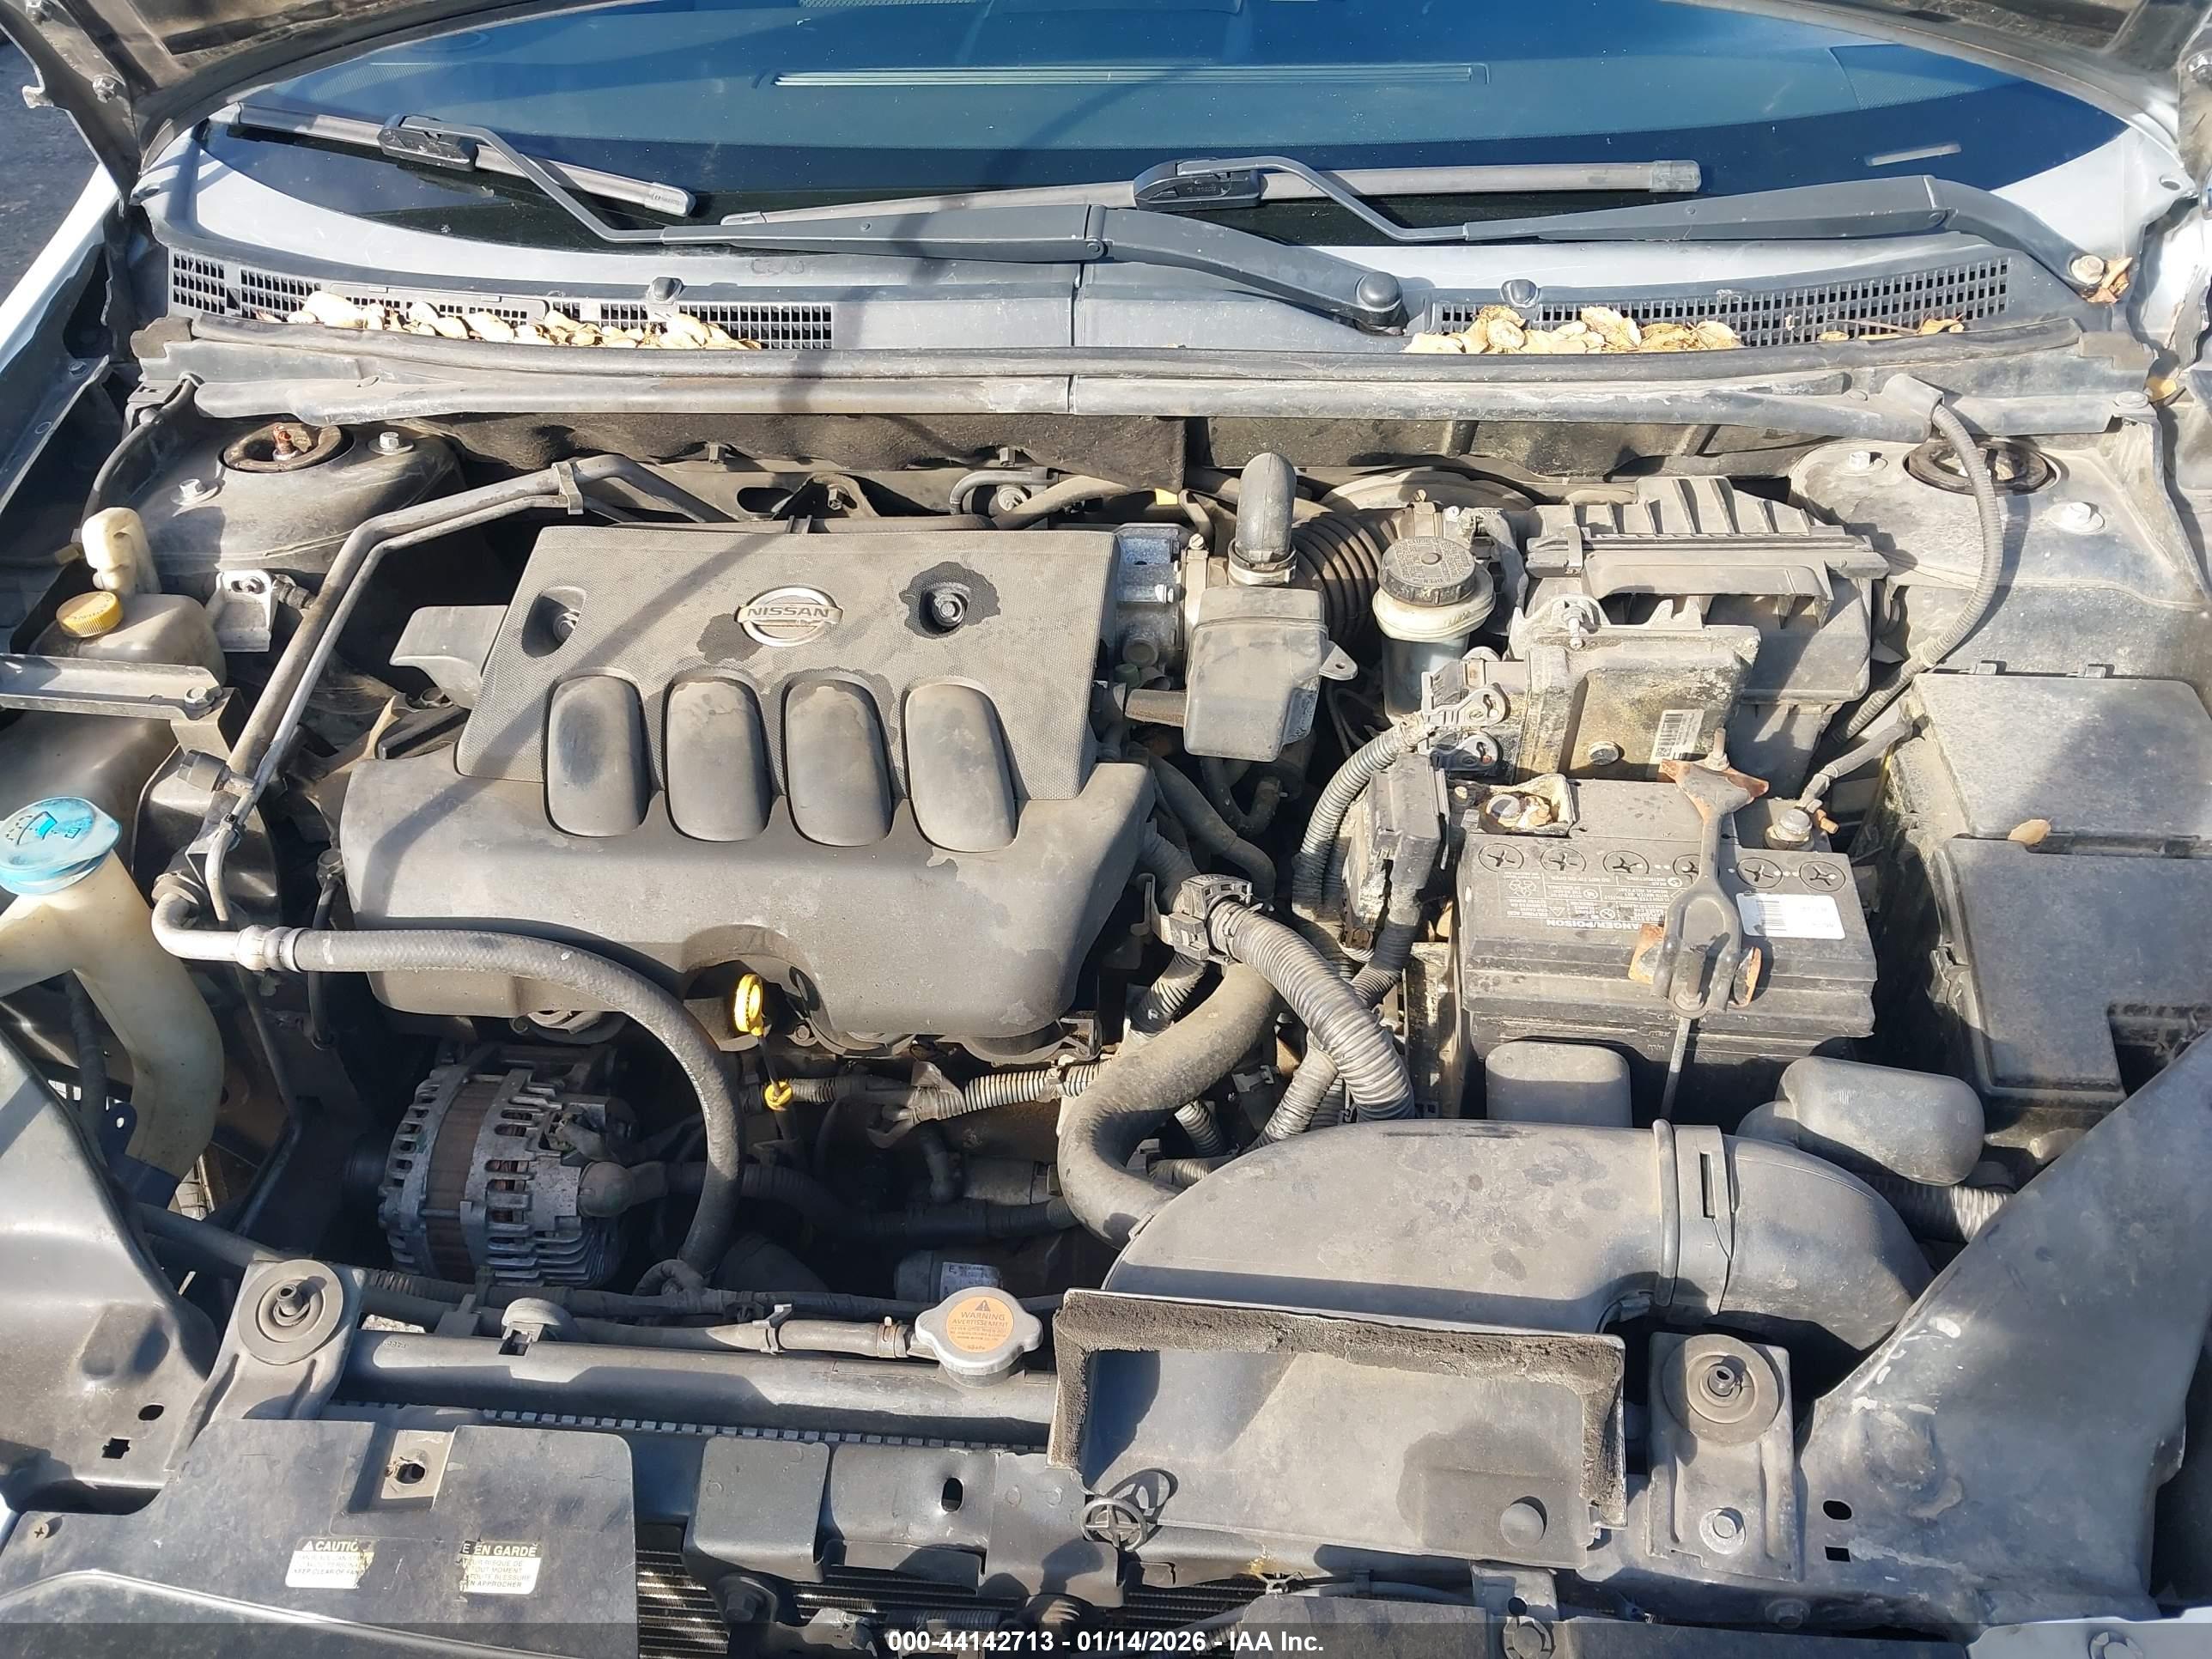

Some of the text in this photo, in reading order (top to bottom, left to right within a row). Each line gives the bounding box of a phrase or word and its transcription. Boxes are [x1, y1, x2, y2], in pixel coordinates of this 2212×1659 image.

[748, 606, 830, 618] NISSAN
[1546, 920, 1641, 929] ANGER/POISON
[961, 1311, 1005, 1321] WARNING
[474, 1545, 491, 1555] EN
